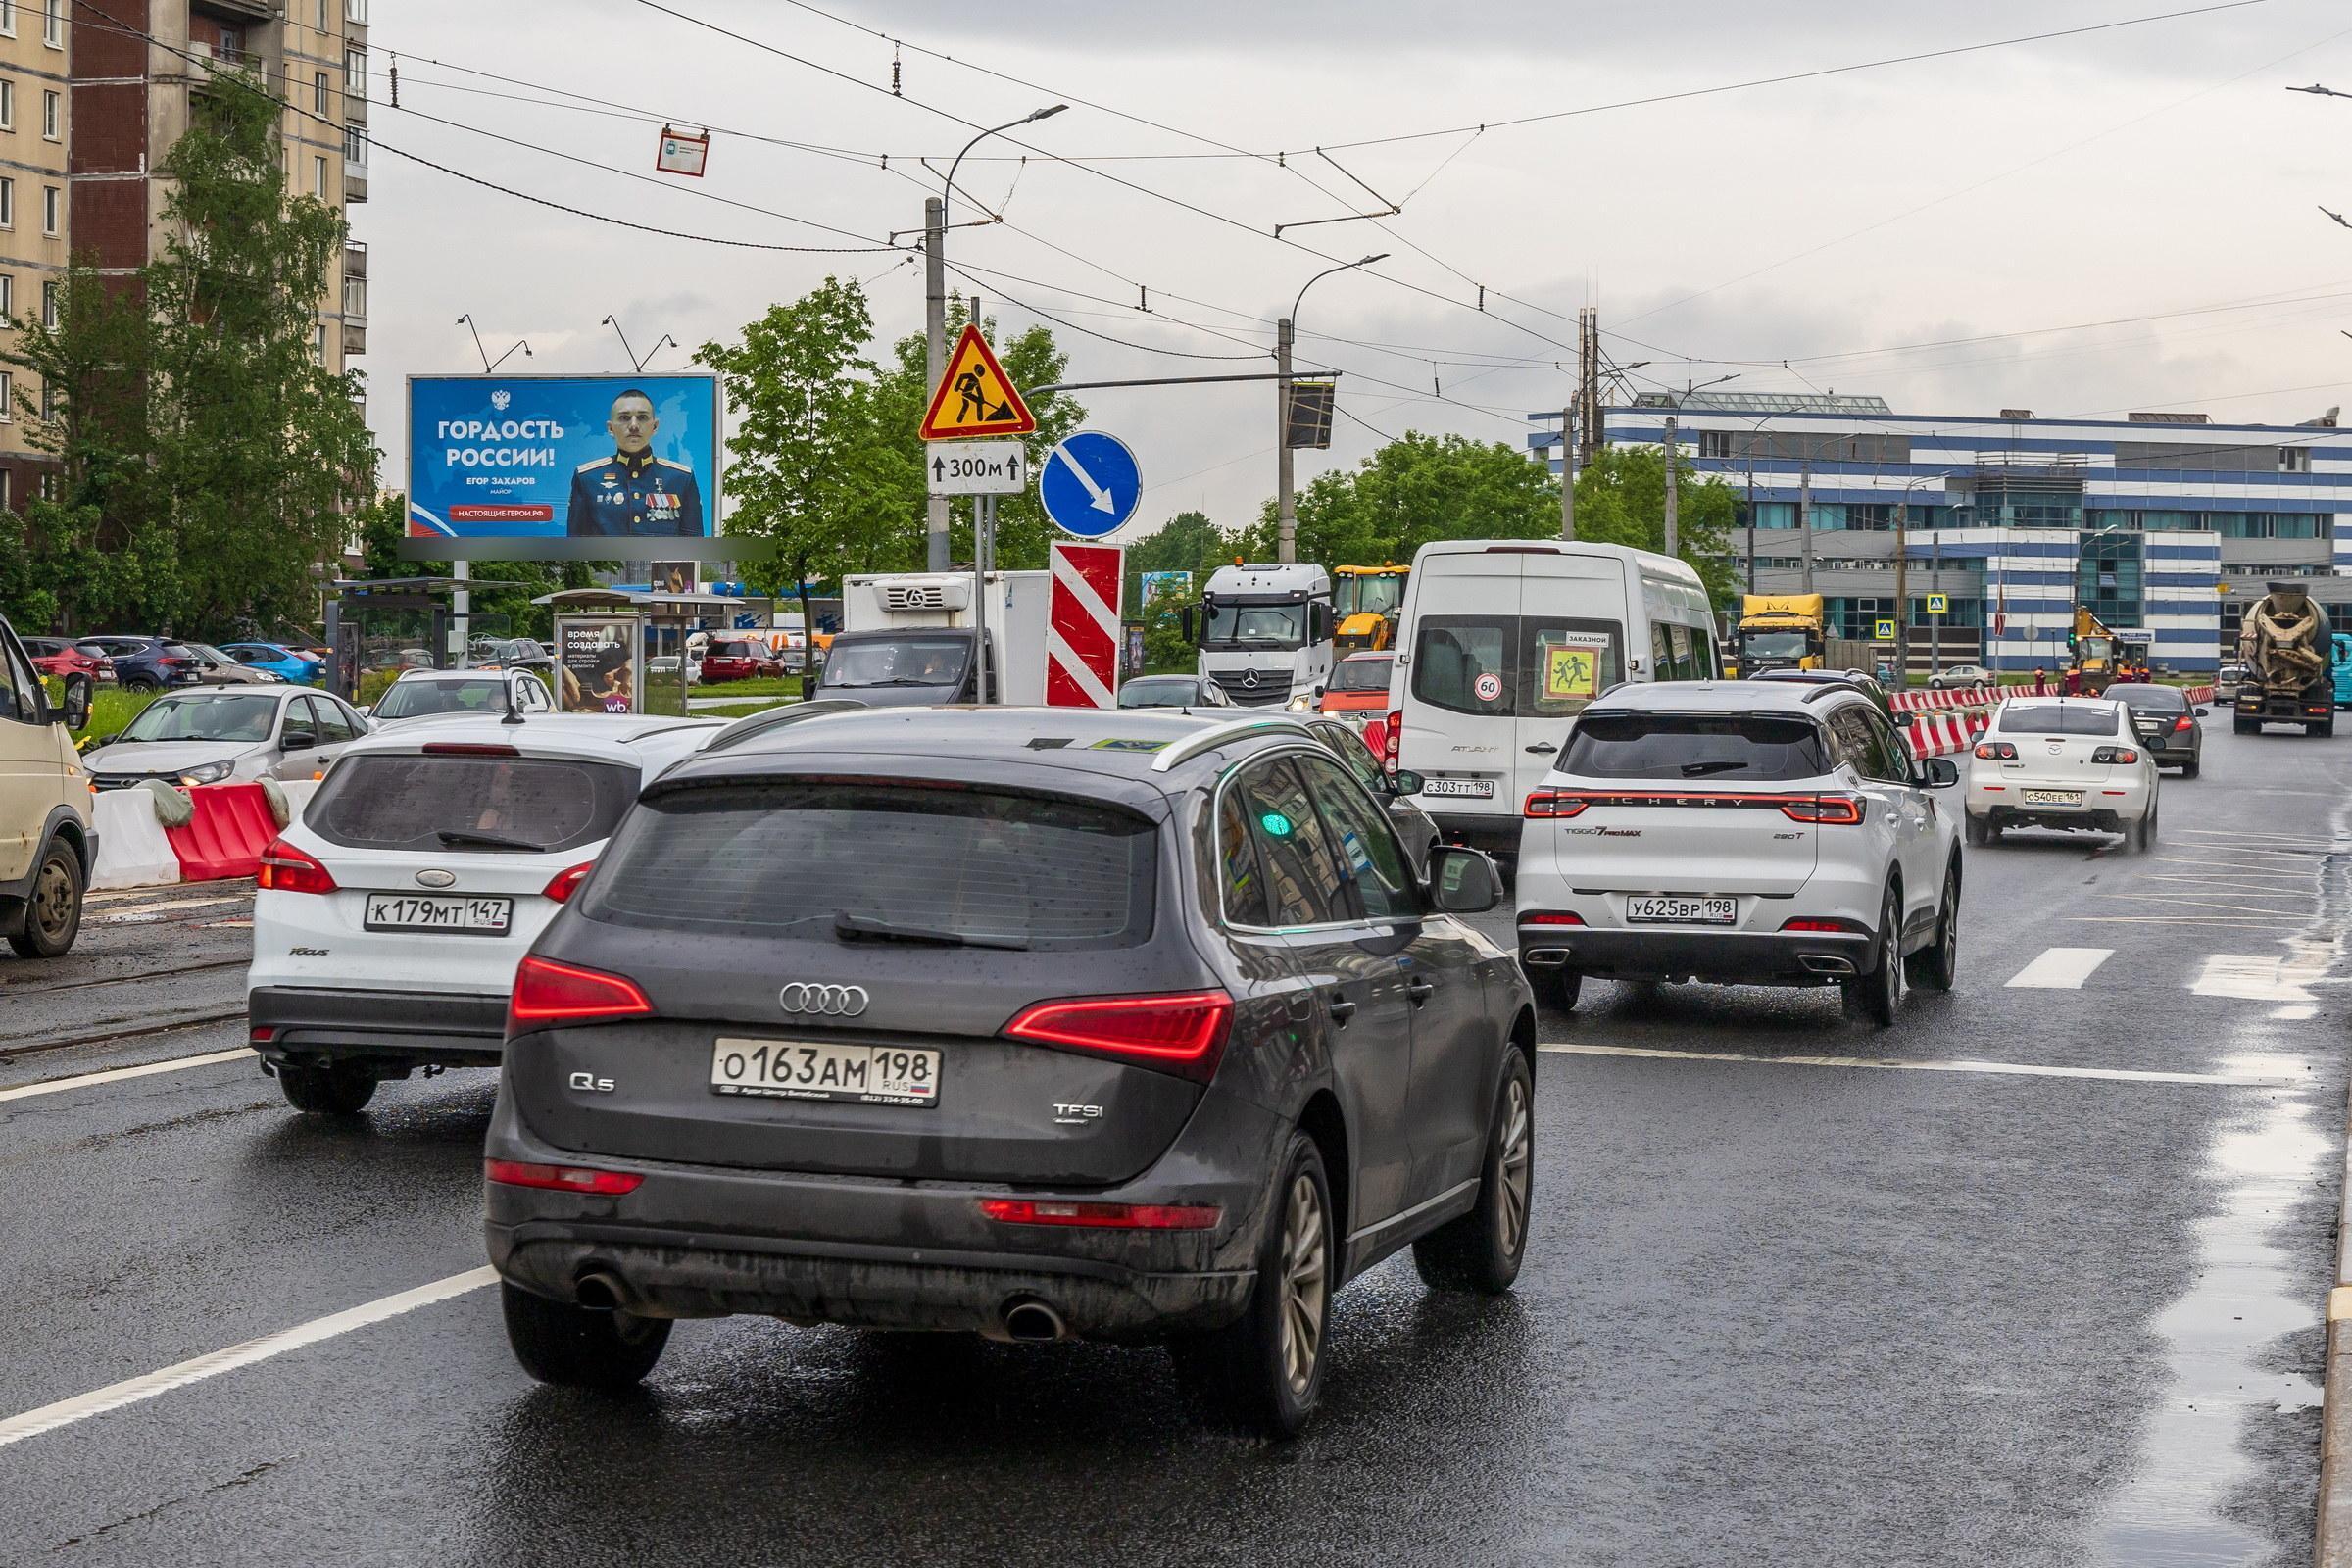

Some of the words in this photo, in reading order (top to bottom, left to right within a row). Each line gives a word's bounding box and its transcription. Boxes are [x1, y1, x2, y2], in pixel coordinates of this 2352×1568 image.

[438, 420, 564, 442] ГОРДОСТЬ
[446, 448, 555, 466] РОССИИ!
[567, 630, 600, 639] время
[567, 641, 621, 650] создавать
[1481, 681, 1495, 692] 60
[606, 700, 626, 712] wb
[1426, 782, 1470, 793] С303ТТ
[1473, 782, 1490, 792] 198
[1622, 797, 1742, 807] CHERY
[374, 899, 463, 924] К179МТ
[468, 901, 503, 918] 147
[1634, 900, 1700, 916] У625ВР
[1705, 900, 1732, 913] 198
[724, 1046, 867, 1088] О163АМ
[875, 1051, 927, 1082] 198
[569, 1072, 615, 1091] Q5
[883, 1080, 909, 1091] RUS
[1053, 1103, 1103, 1117] TFSI
